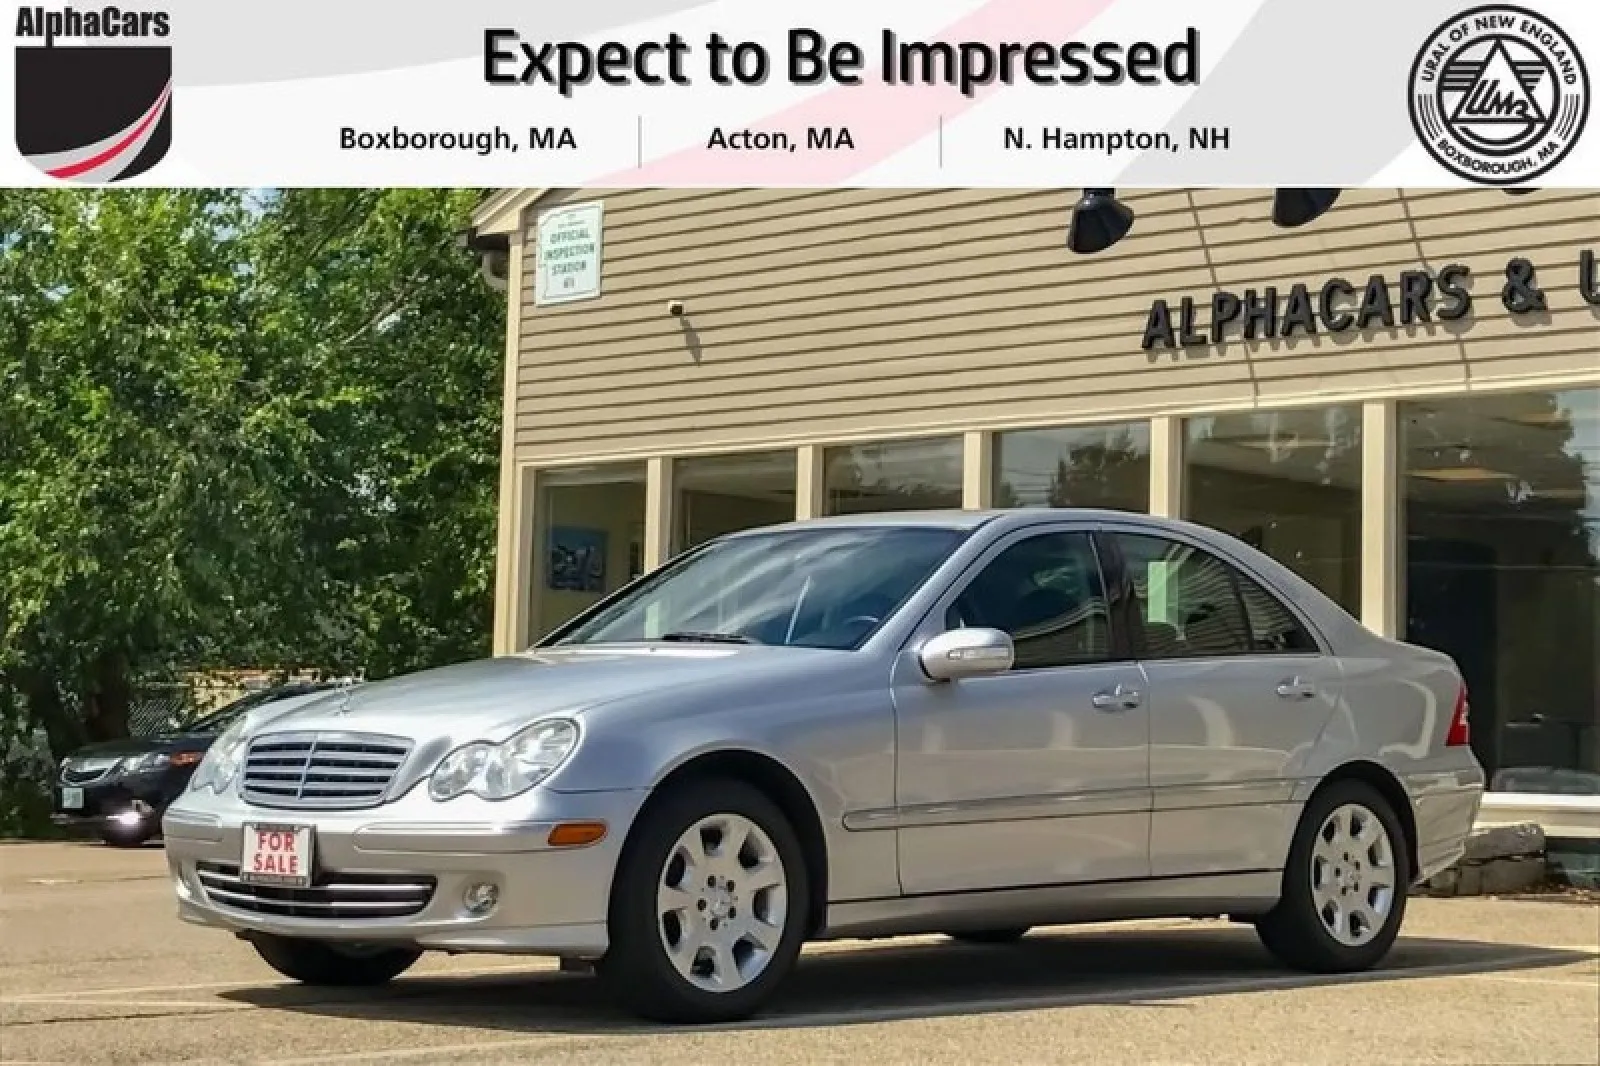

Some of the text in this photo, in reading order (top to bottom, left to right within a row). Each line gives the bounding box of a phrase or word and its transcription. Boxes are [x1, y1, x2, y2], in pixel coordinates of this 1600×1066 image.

[1142, 264, 1471, 350] ALPHACARS
[1502, 256, 1547, 313] &
[257, 830, 295, 852] FOR
[253, 852, 299, 874] SALE
